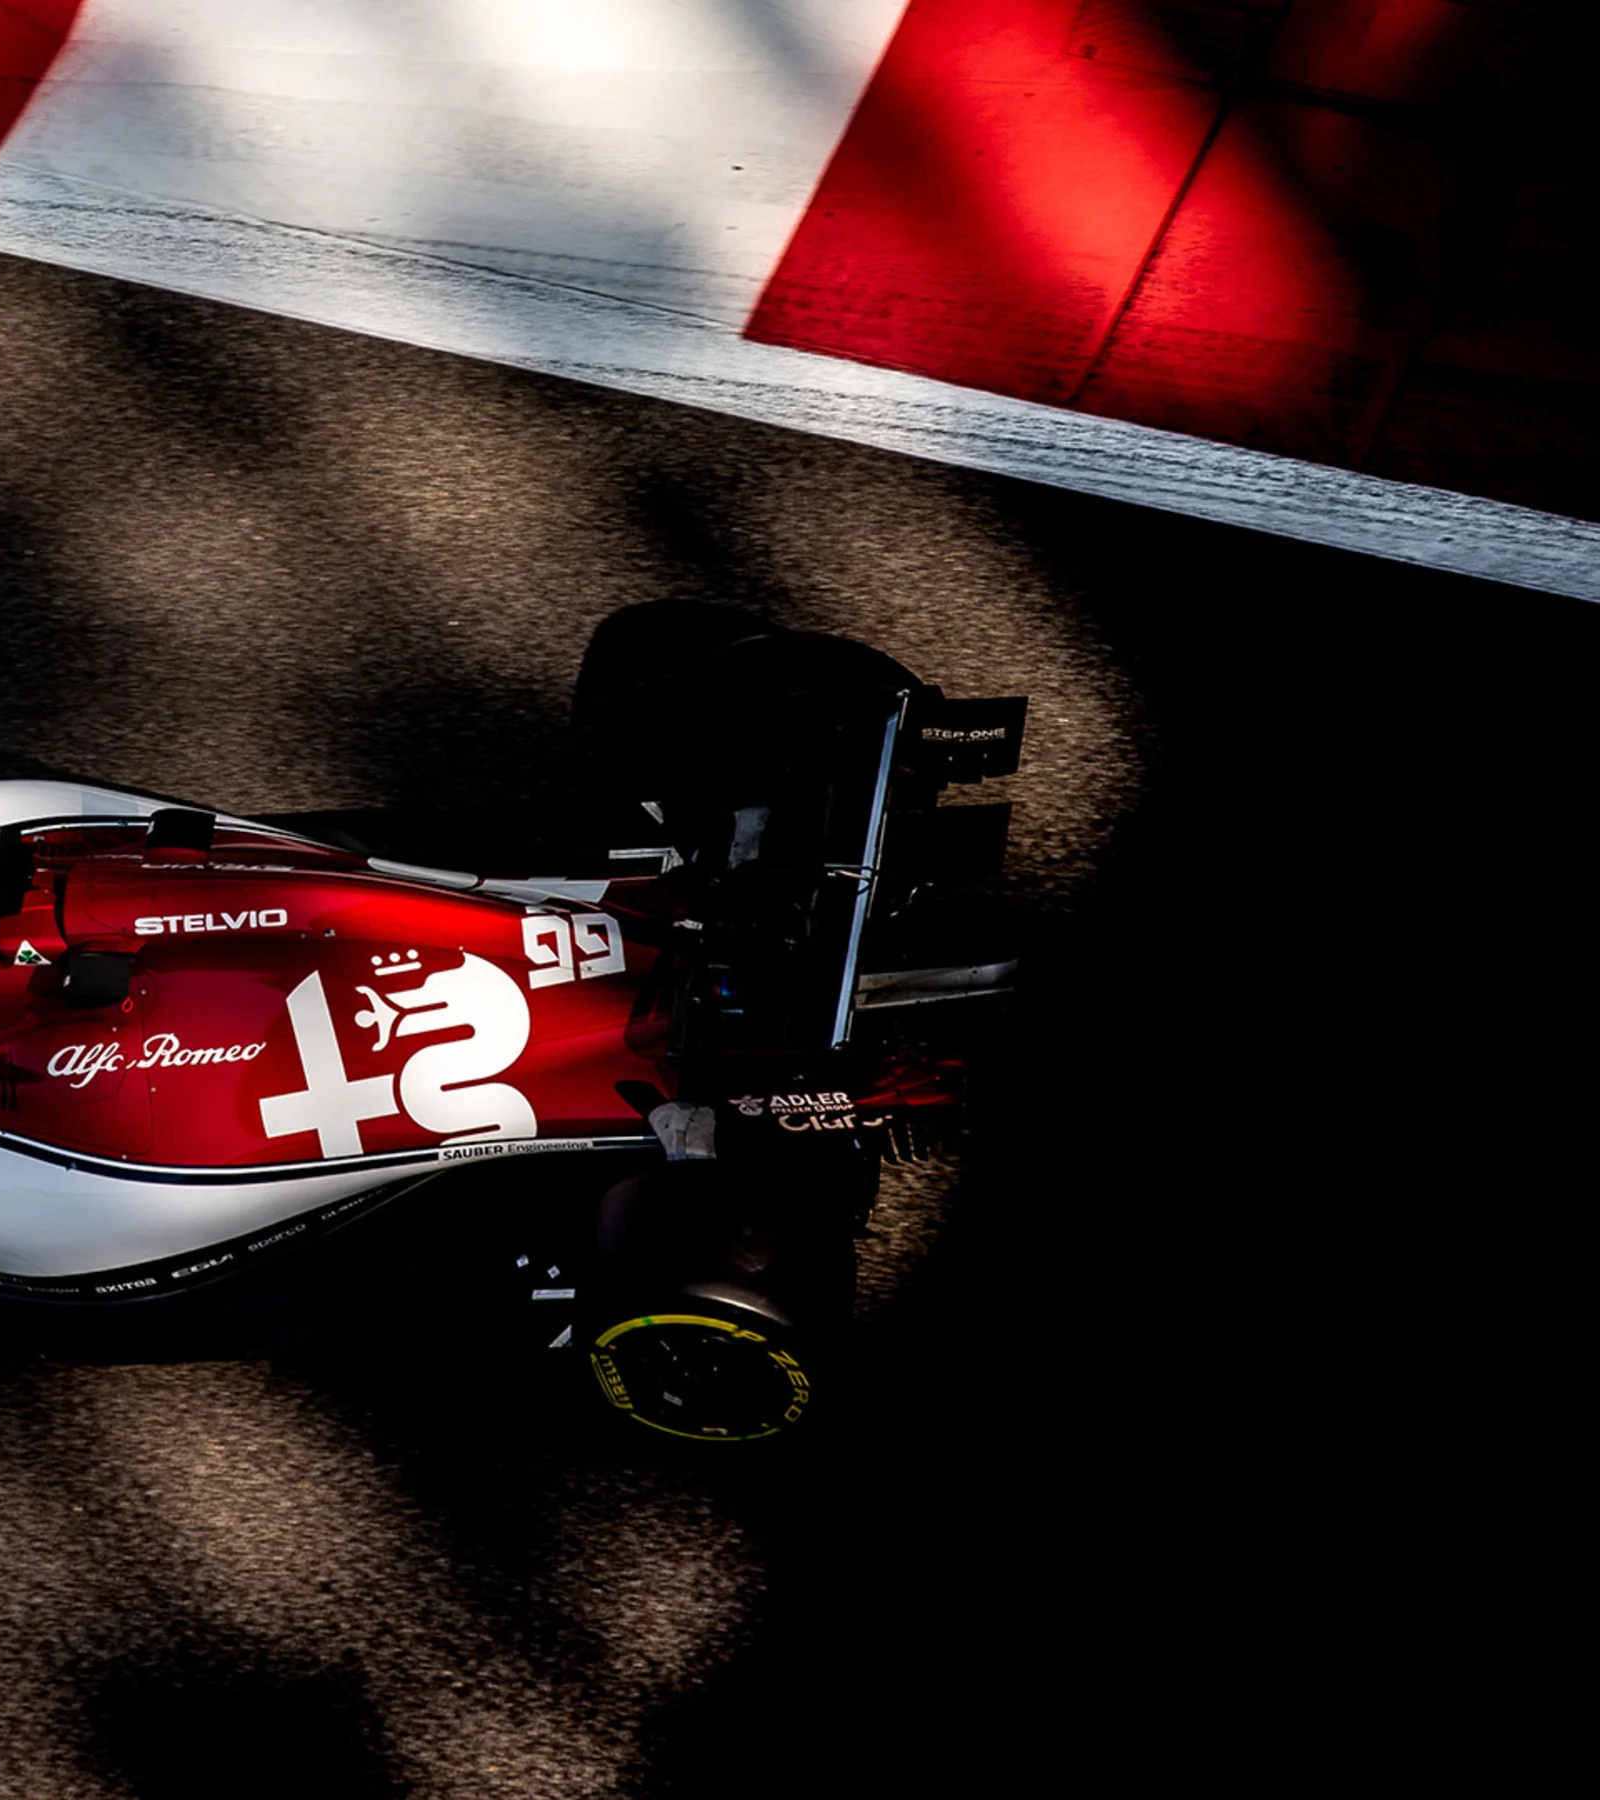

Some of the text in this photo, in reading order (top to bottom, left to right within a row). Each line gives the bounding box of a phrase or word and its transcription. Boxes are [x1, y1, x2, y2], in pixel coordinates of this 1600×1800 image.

[134, 908, 288, 935] STELVIO
[521, 912, 626, 990] 99
[137, 1033, 267, 1068] Romeo
[770, 1091, 850, 1107] ADLER
[442, 1141, 589, 1161] SAUBER Engineering
